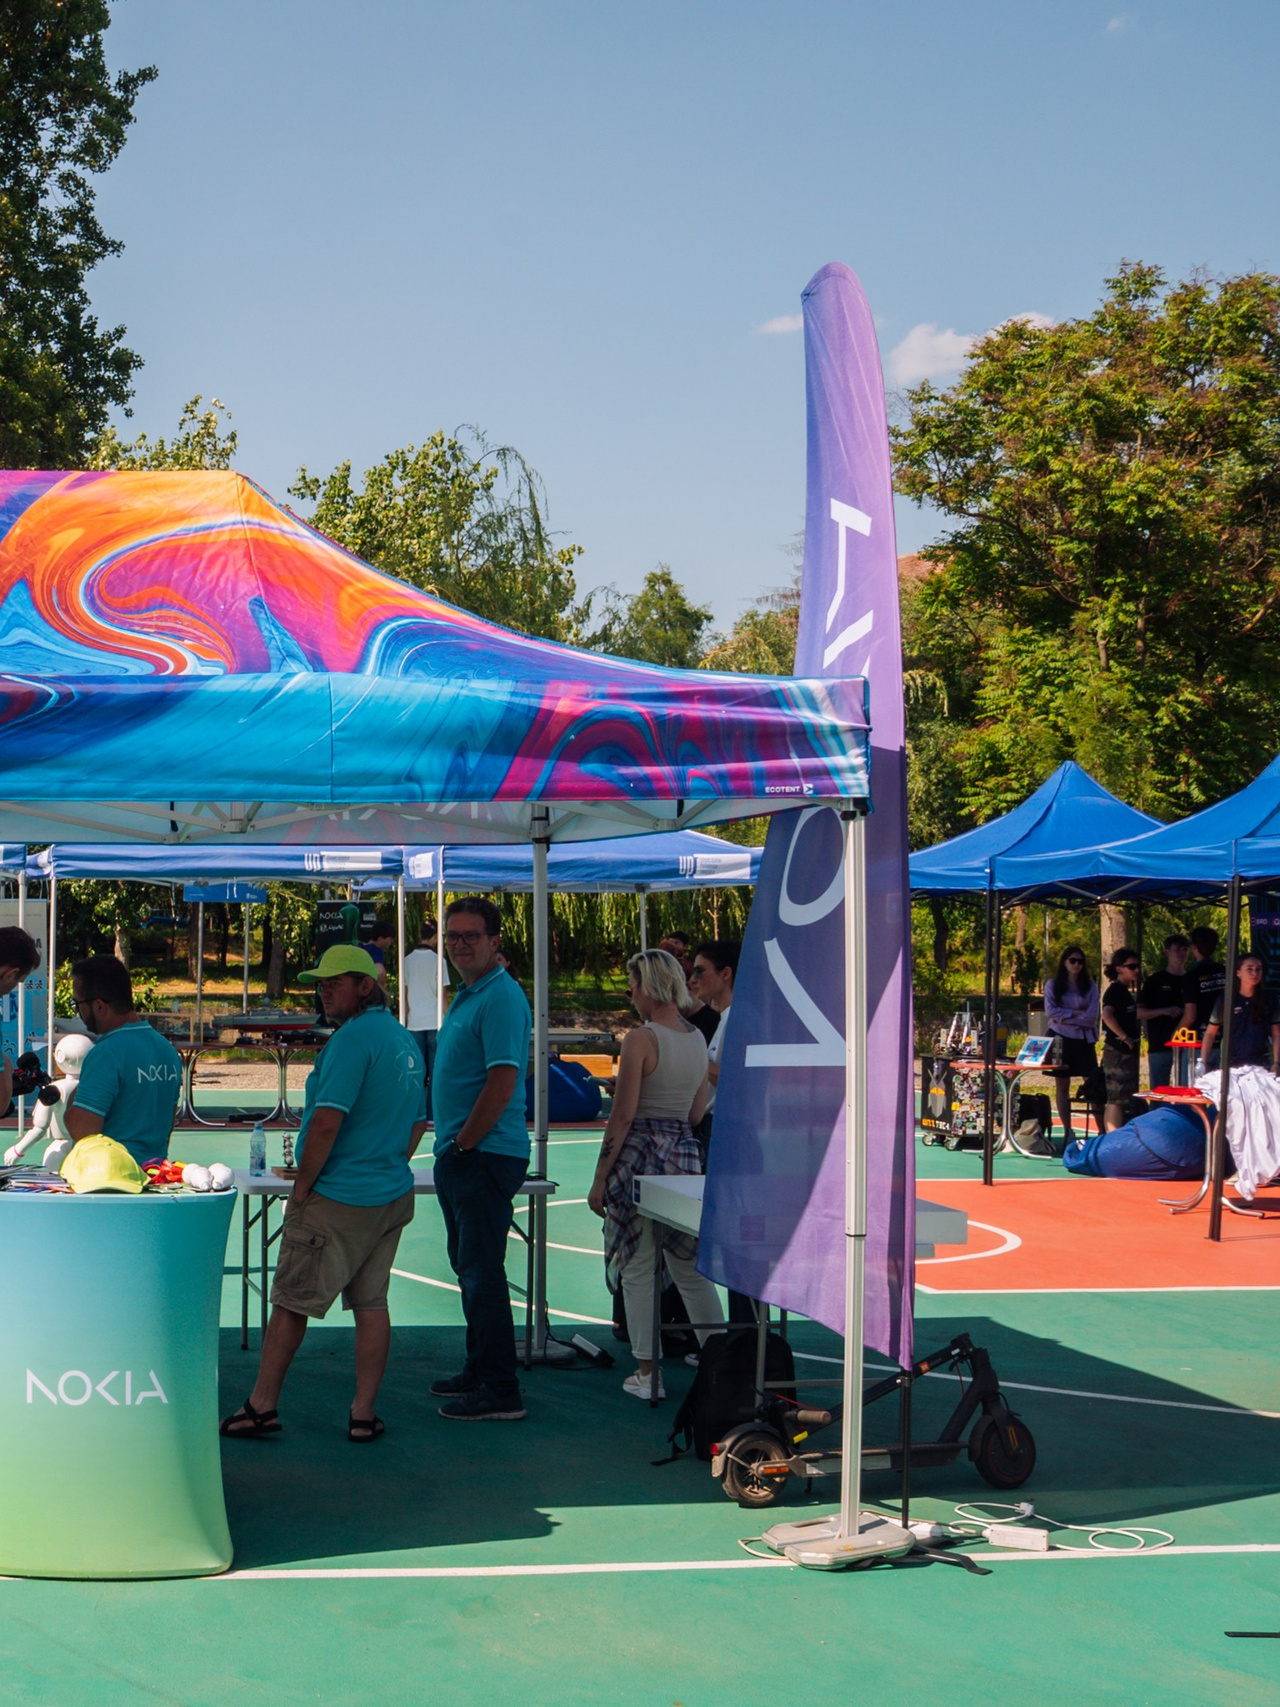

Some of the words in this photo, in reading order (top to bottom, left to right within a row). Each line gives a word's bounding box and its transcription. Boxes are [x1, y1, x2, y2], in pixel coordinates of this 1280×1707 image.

[744, 498, 873, 1067] NOIA
[765, 785, 801, 794] ECOTENT
[320, 911, 344, 920] NOKIA
[137, 1064, 178, 1084] NOKIA
[26, 1367, 169, 1406] NOKIA
